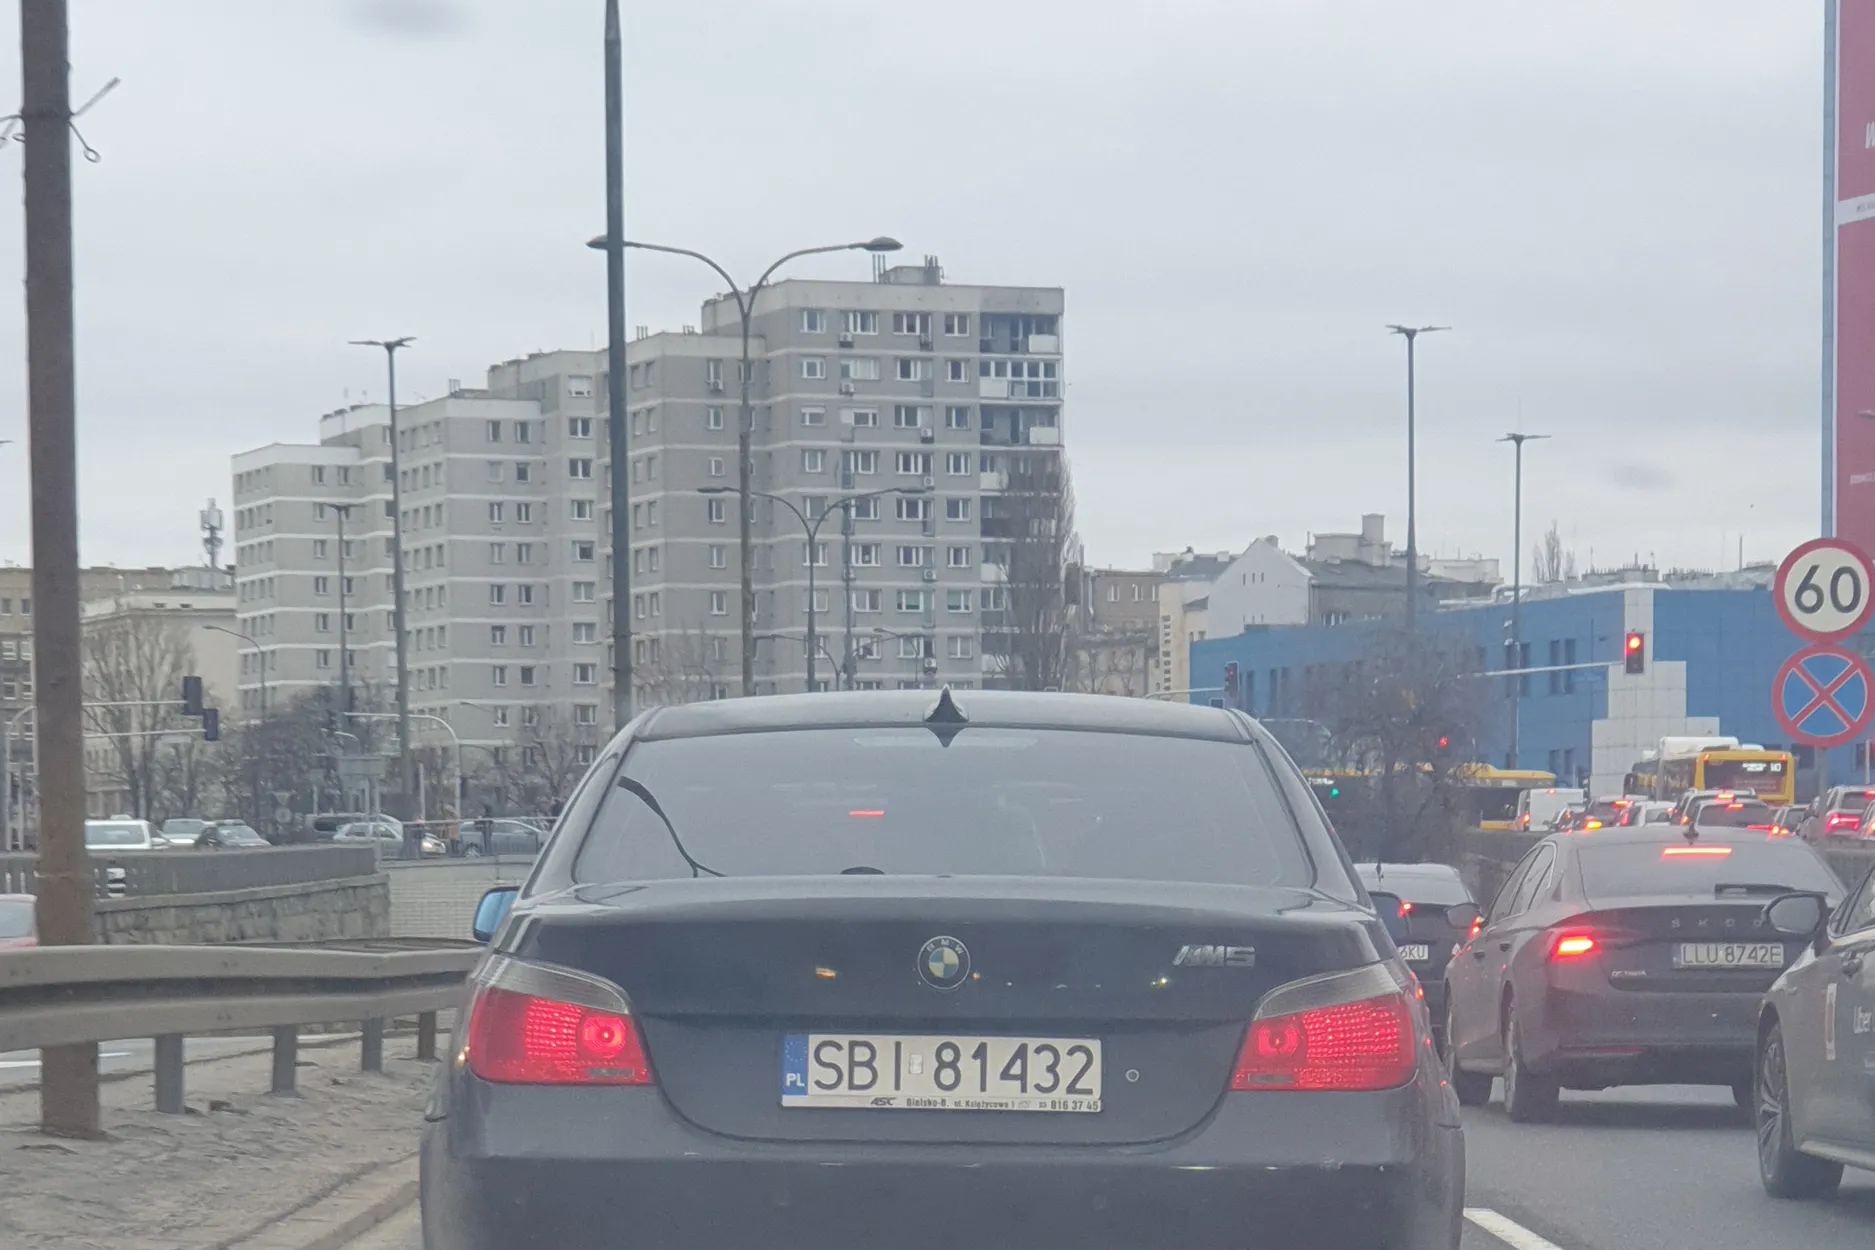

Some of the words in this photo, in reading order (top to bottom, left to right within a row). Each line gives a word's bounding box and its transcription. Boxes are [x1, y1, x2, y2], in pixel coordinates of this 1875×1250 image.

[1794, 564, 1861, 615] 60
[926, 938, 964, 954] BMW
[1682, 945, 1719, 964] LLU
[1724, 945, 1781, 964] 8742E
[813, 1040, 902, 1092] SBI
[933, 1041, 1095, 1096] 81432
[785, 1073, 806, 1087] PL
[870, 1096, 897, 1106] ASC
[1071, 1100, 1083, 1111] 37
[1086, 1100, 1099, 1111] 45
